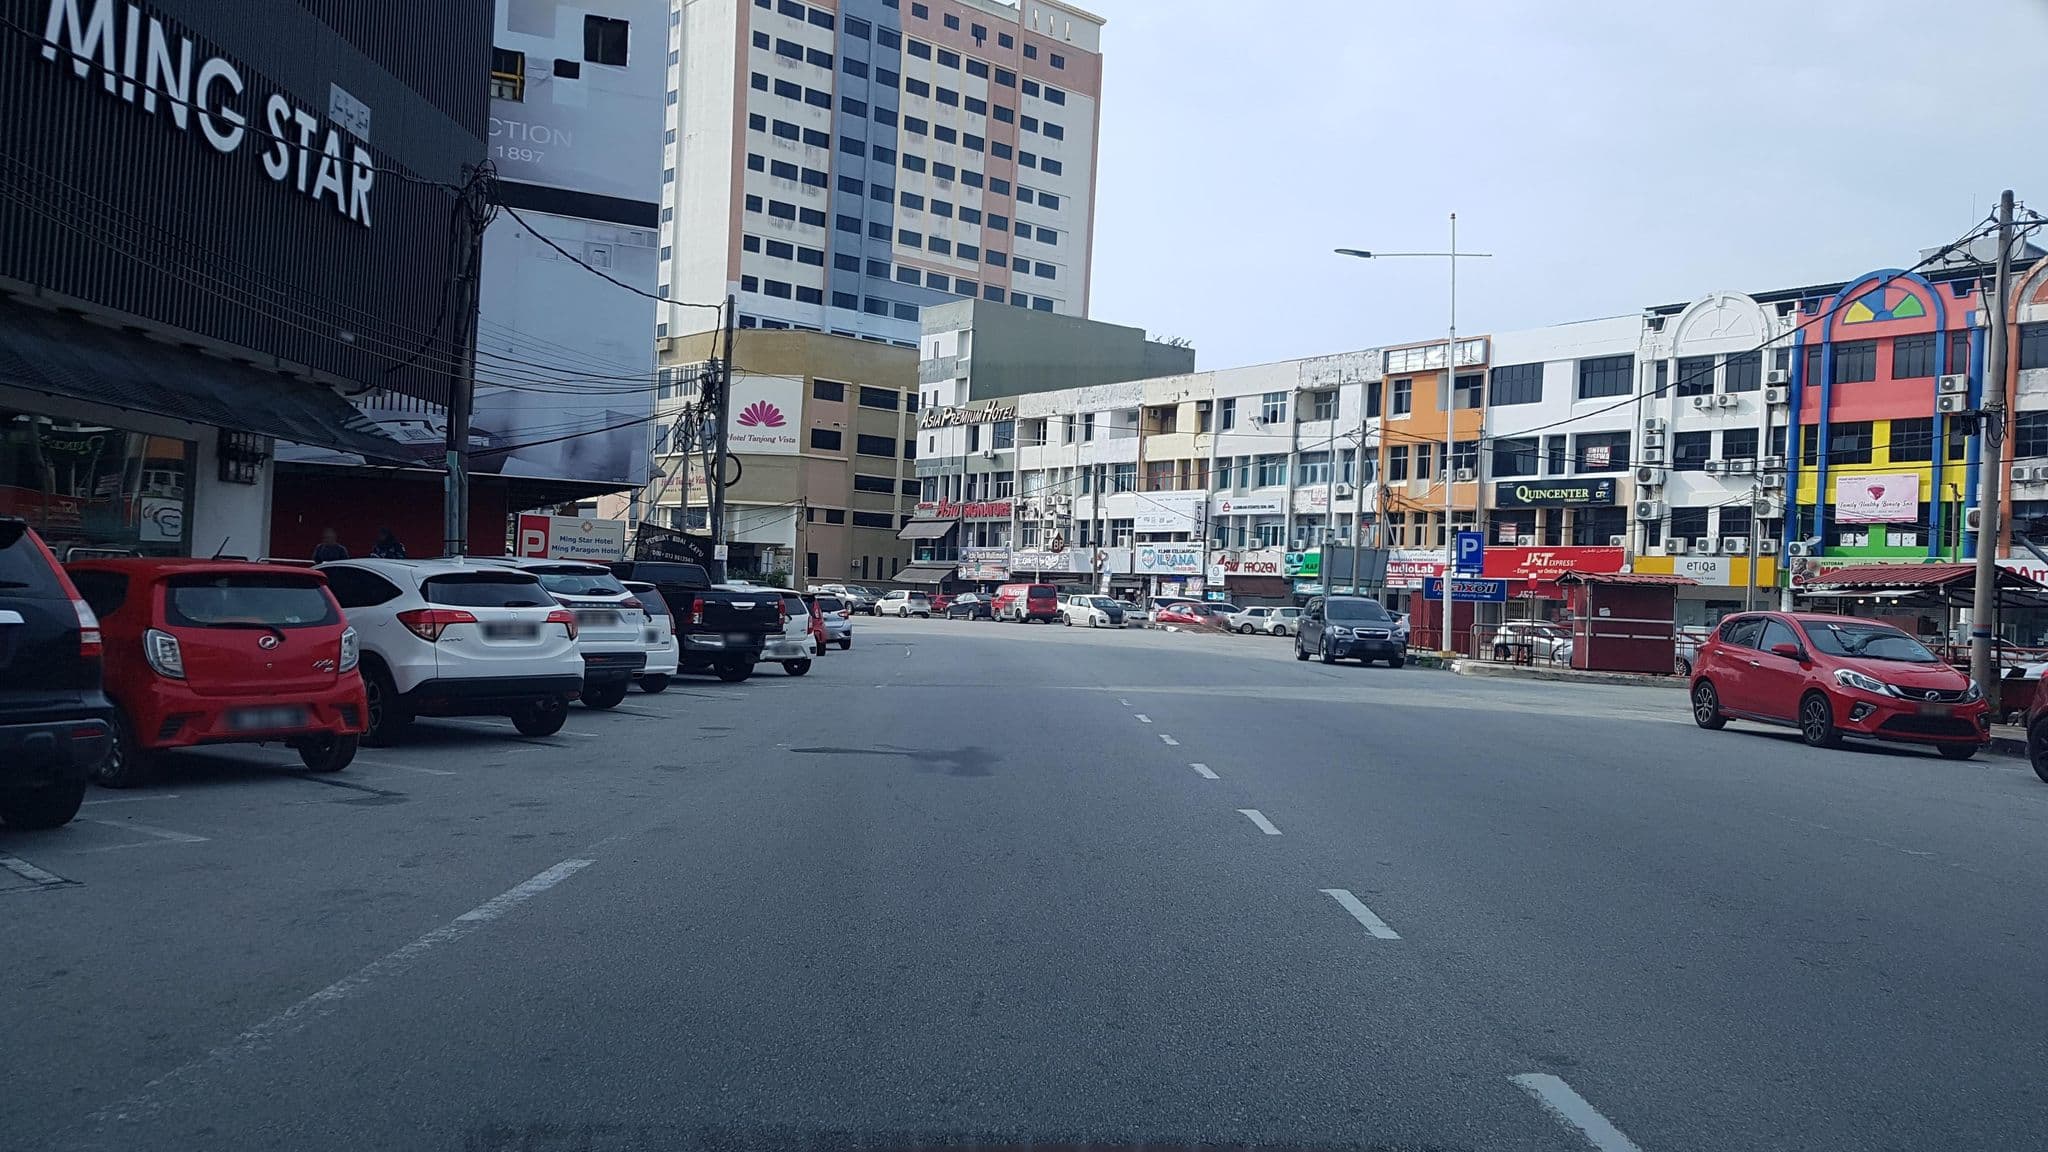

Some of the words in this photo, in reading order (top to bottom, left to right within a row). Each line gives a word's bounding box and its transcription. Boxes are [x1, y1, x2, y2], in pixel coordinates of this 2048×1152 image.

[42, 0, 245, 152] MING
[262, 94, 373, 228] STAR
[496, 146, 544, 163] 1897
[921, 409, 940, 428] ASIA
[940, 407, 983, 426] PREMIUM
[982, 400, 1015, 421] HOTEL
[748, 434, 776, 443] Tanjong
[778, 435, 796, 443] Vista
[1516, 485, 1589, 503] QUINCENTER
[963, 502, 1011, 518] SIGNATURE
[522, 529, 545, 558] P
[559, 536, 577, 545] Ming
[578, 536, 593, 545] Star
[594, 537, 613, 545] Hotel
[1462, 538, 1478, 559] P
[551, 544, 569, 554] Ming
[570, 545, 599, 555] Paragon
[601, 546, 620, 555] Hotel
[1521, 552, 1555, 566] J&T
[1244, 562, 1276, 573] FROZEN
[1386, 563, 1434, 574] AudioLab
